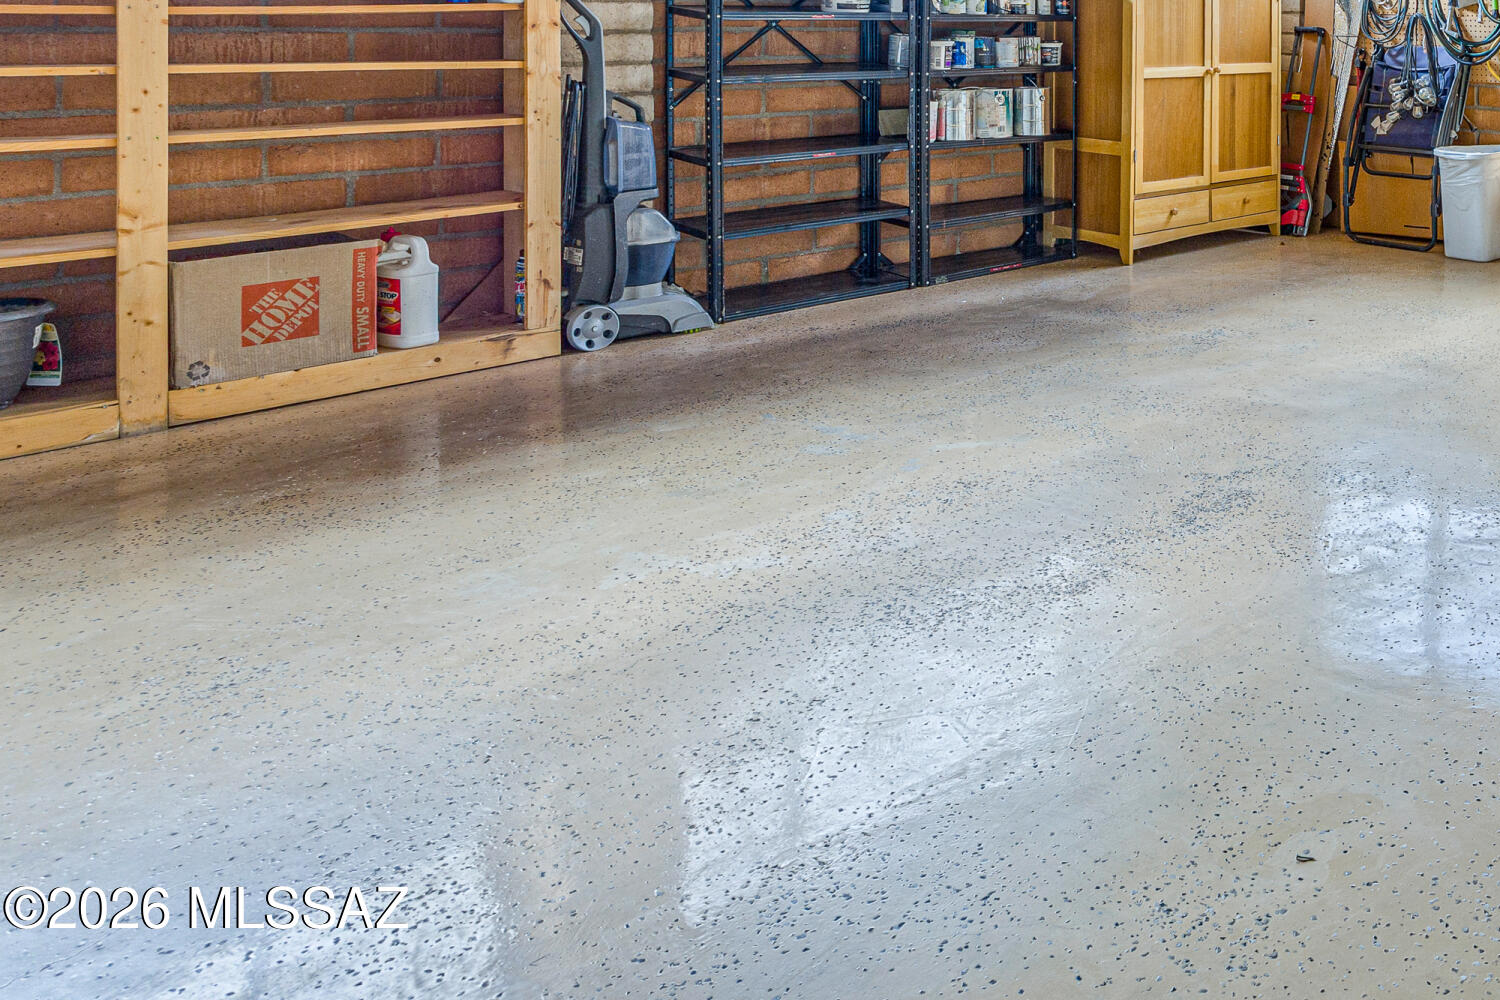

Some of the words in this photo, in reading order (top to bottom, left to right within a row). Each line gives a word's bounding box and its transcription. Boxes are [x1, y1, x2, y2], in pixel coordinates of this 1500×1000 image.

[356, 251, 366, 279] HEAVY
[248, 287, 282, 314] THE
[356, 281, 365, 303] DUTY
[241, 278, 320, 345] HOME
[272, 298, 320, 341] DEPOT
[356, 306, 370, 349] SMALL
